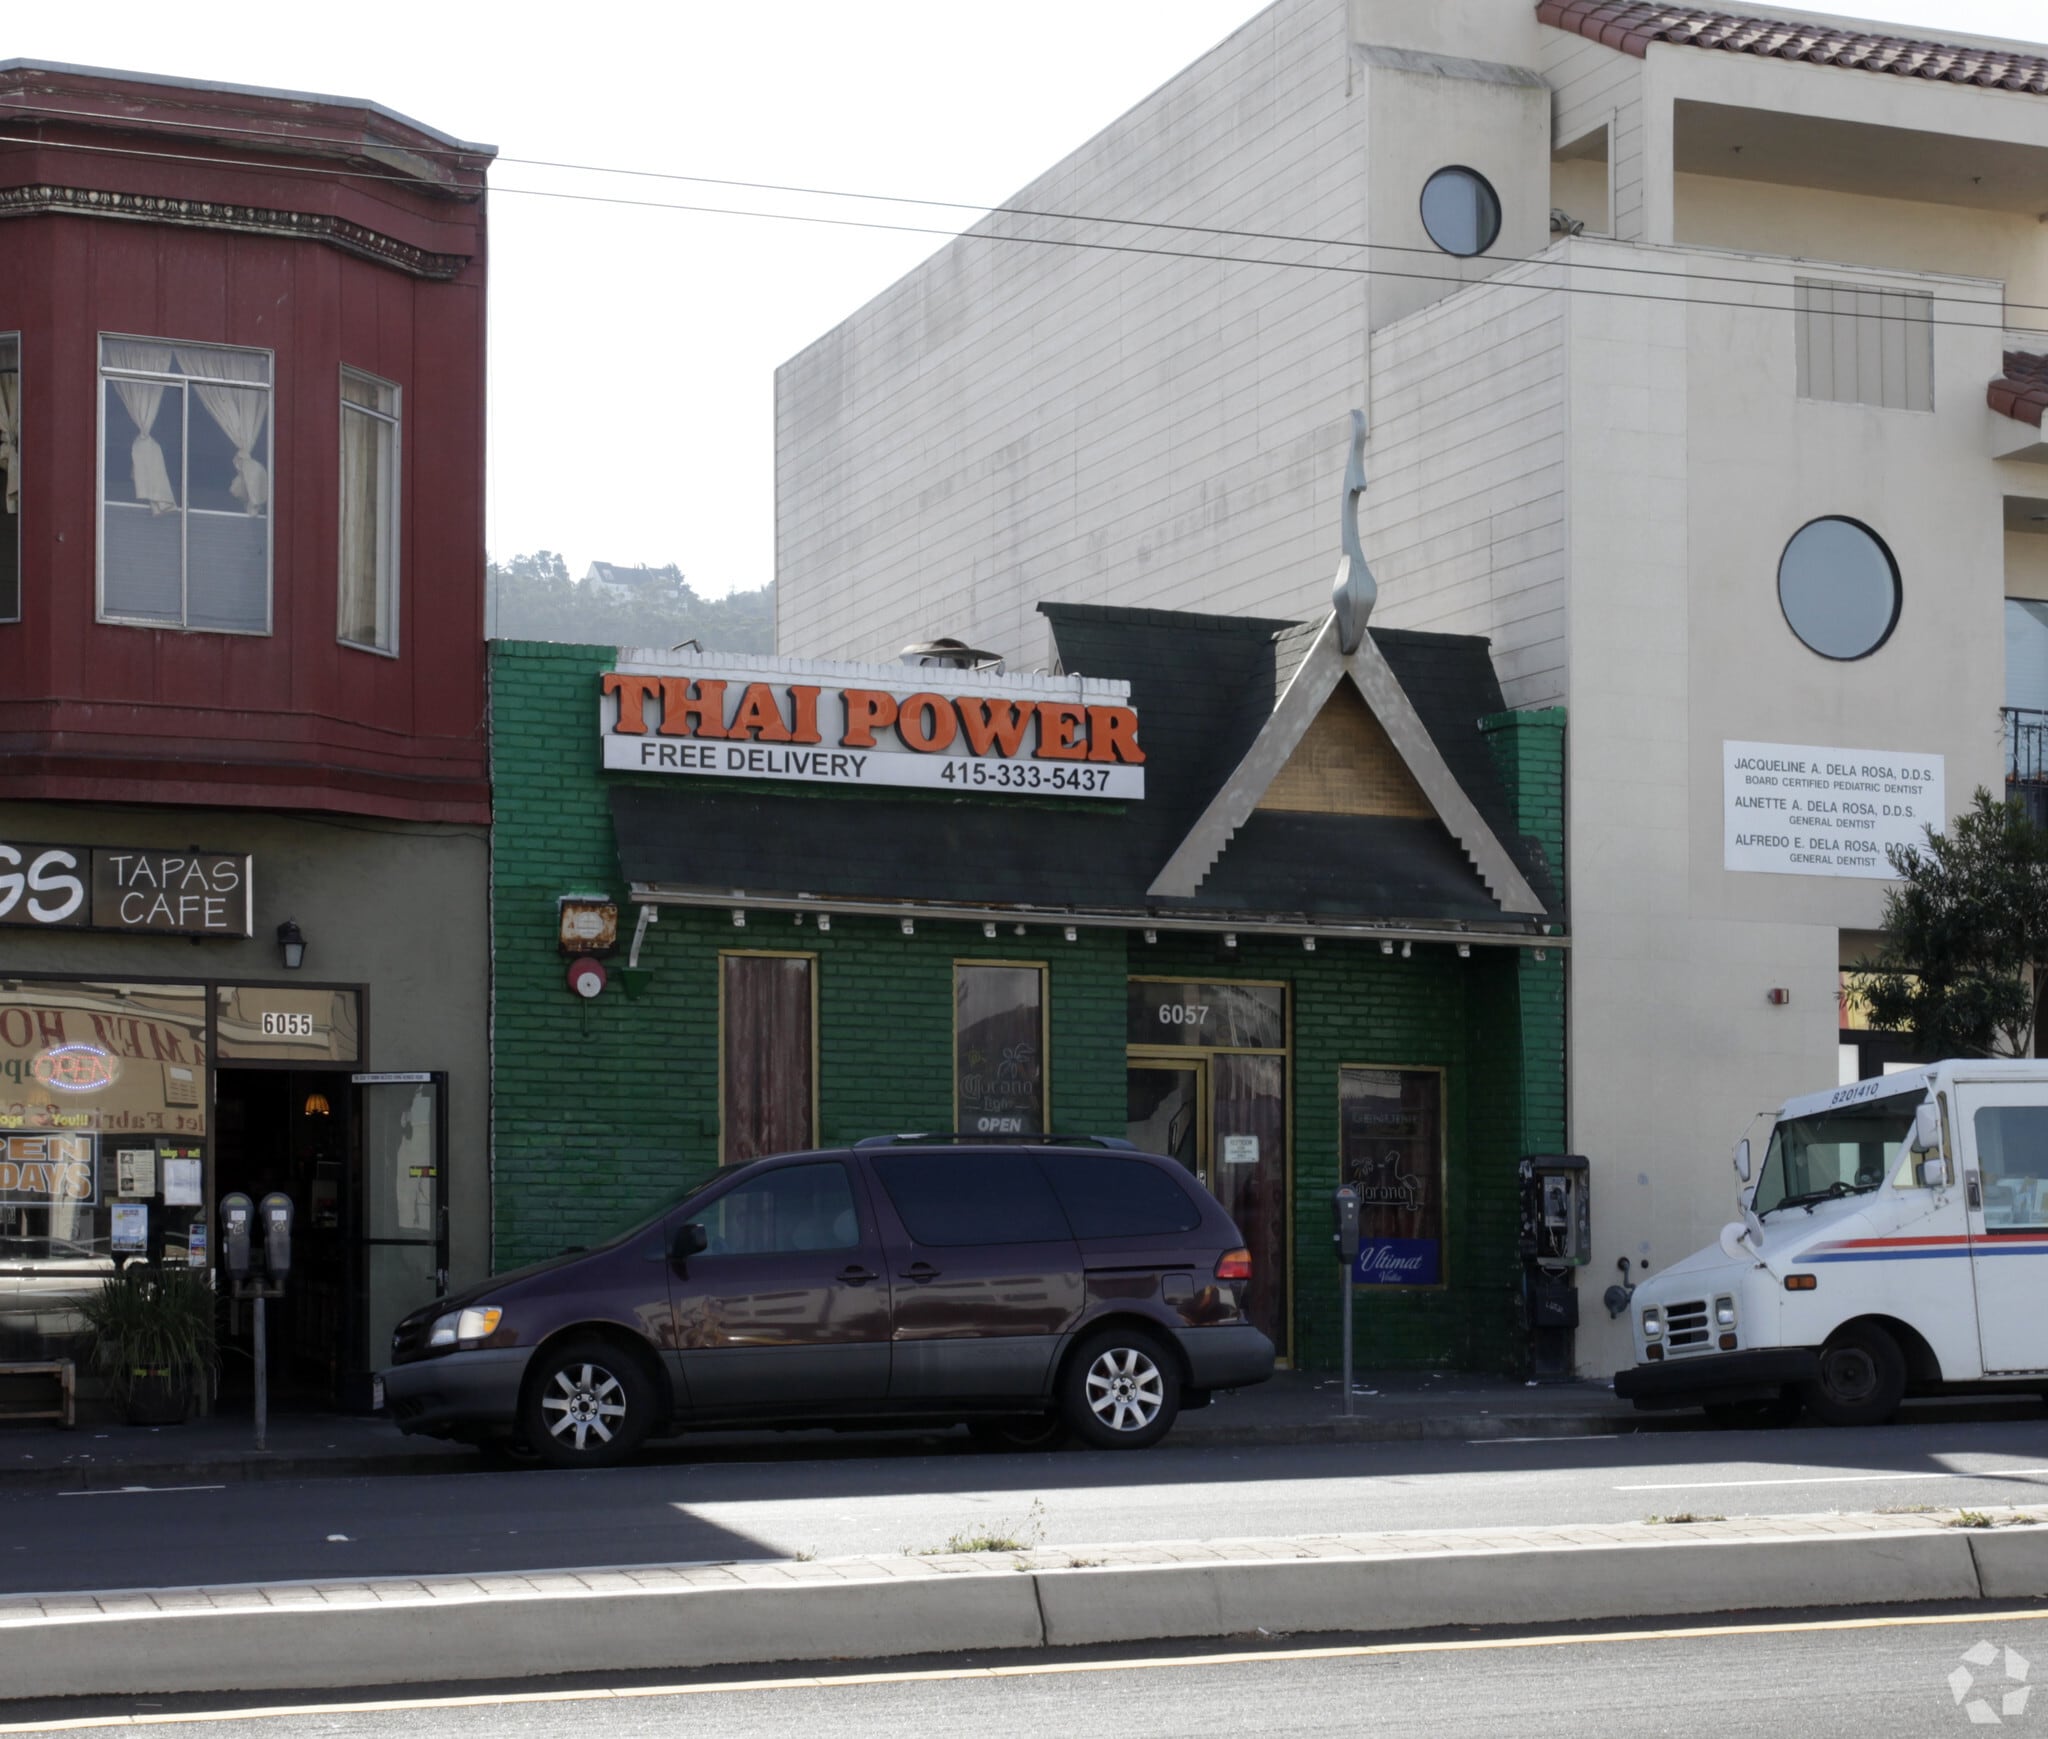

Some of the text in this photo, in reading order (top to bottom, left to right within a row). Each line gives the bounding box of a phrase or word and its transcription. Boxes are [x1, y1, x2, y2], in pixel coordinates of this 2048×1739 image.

[602, 672, 1147, 765] THAI POWER
[641, 742, 1111, 792] FREE DELIVERY 415-333-5437
[1734, 758, 1935, 782] JACQUELINE A. DELA ROSA, D.D.S.
[1745, 775, 1923, 796] BOARD CERTIFIED PEDIATRIC DENTIST
[1735, 796, 1916, 818] ALNETTE A. DELA ROSA, D.D.S.
[1789, 815, 1876, 830] GENERAL DENTIST
[1735, 834, 1790, 848] ALFREDO
[1794, 837, 1804, 849] E.
[1809, 837, 1840, 851] DELA
[1844, 840, 1880, 854] ROSA,
[1789, 853, 1877, 867] GENERAL DENTIST
[109, 855, 240, 893] TAPAS
[120, 892, 229, 929] CAFE
[262, 1012, 312, 1035] 6055
[1158, 1003, 1209, 1025] 6057
[34, 1054, 115, 1083] OPEN
[1831, 1082, 1880, 1105] 8201410
[977, 1116, 1022, 1132] OPEN
[0, 1136, 92, 1162] EN
[1360, 1244, 1423, 1273] Ultimat
